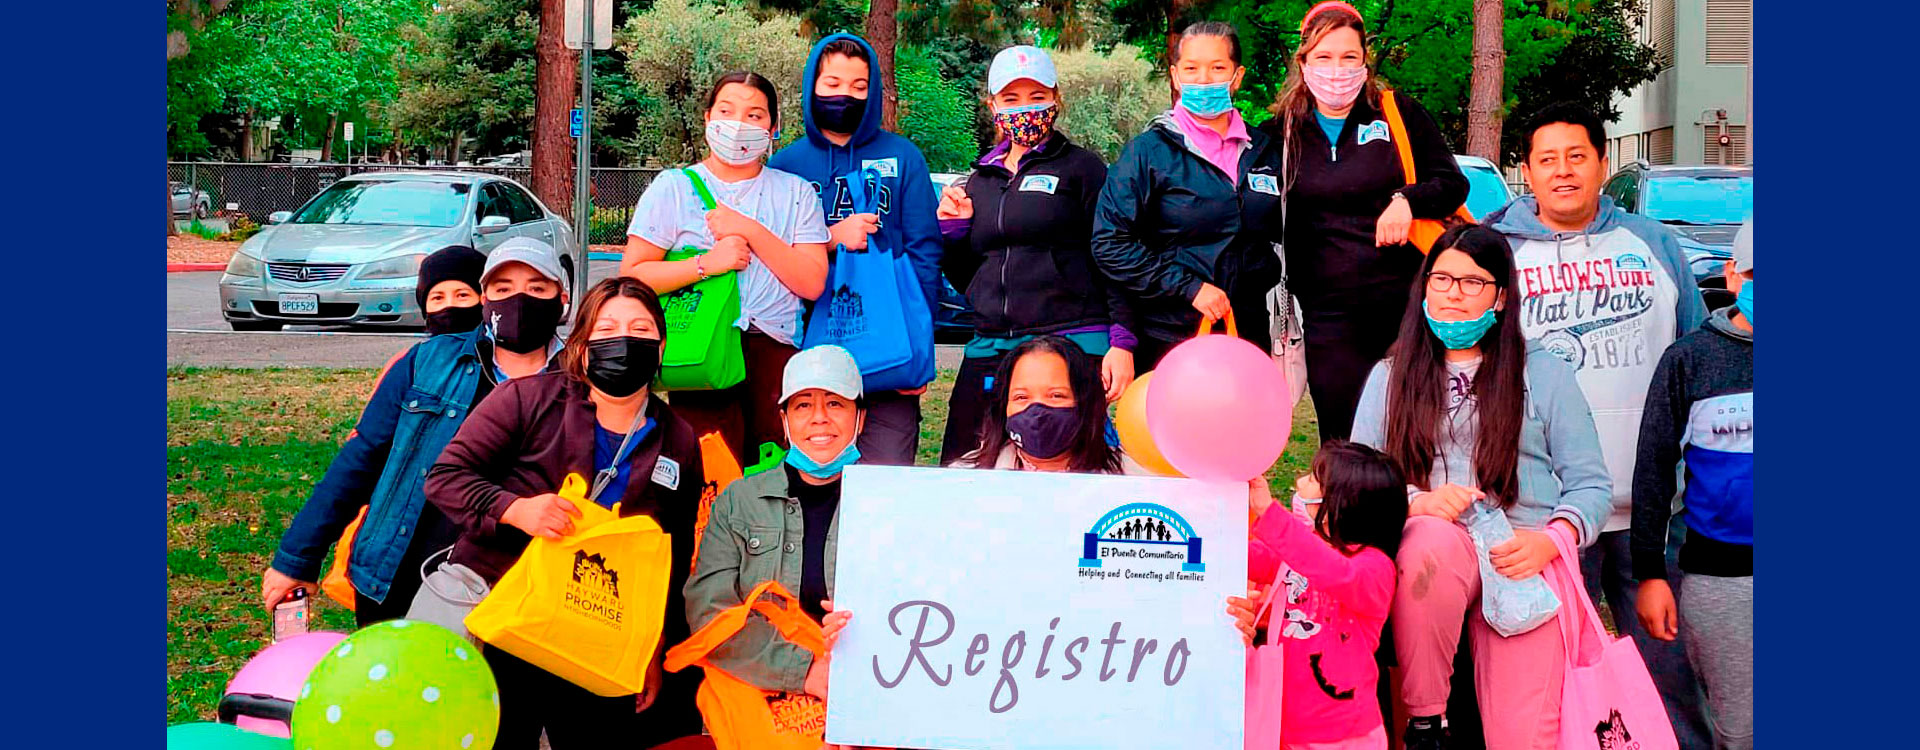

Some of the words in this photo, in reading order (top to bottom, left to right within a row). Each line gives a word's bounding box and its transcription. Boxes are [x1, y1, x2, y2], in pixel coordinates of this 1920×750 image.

[1516, 258, 1655, 298] ELLOWSTONE
[1591, 283, 1645, 317] Park
[1101, 547, 1109, 557] El
[1112, 547, 1137, 558] Puente
[1139, 548, 1184, 560] Comunitario
[1079, 568, 1105, 580] Helping
[1107, 569, 1120, 578] and
[1124, 569, 1163, 582] Connecting
[1165, 571, 1174, 580] all
[1176, 571, 1204, 581] families
[565, 592, 622, 623] PROMISE
[566, 581, 624, 610] HAYWARD
[872, 599, 1191, 713] Registro
